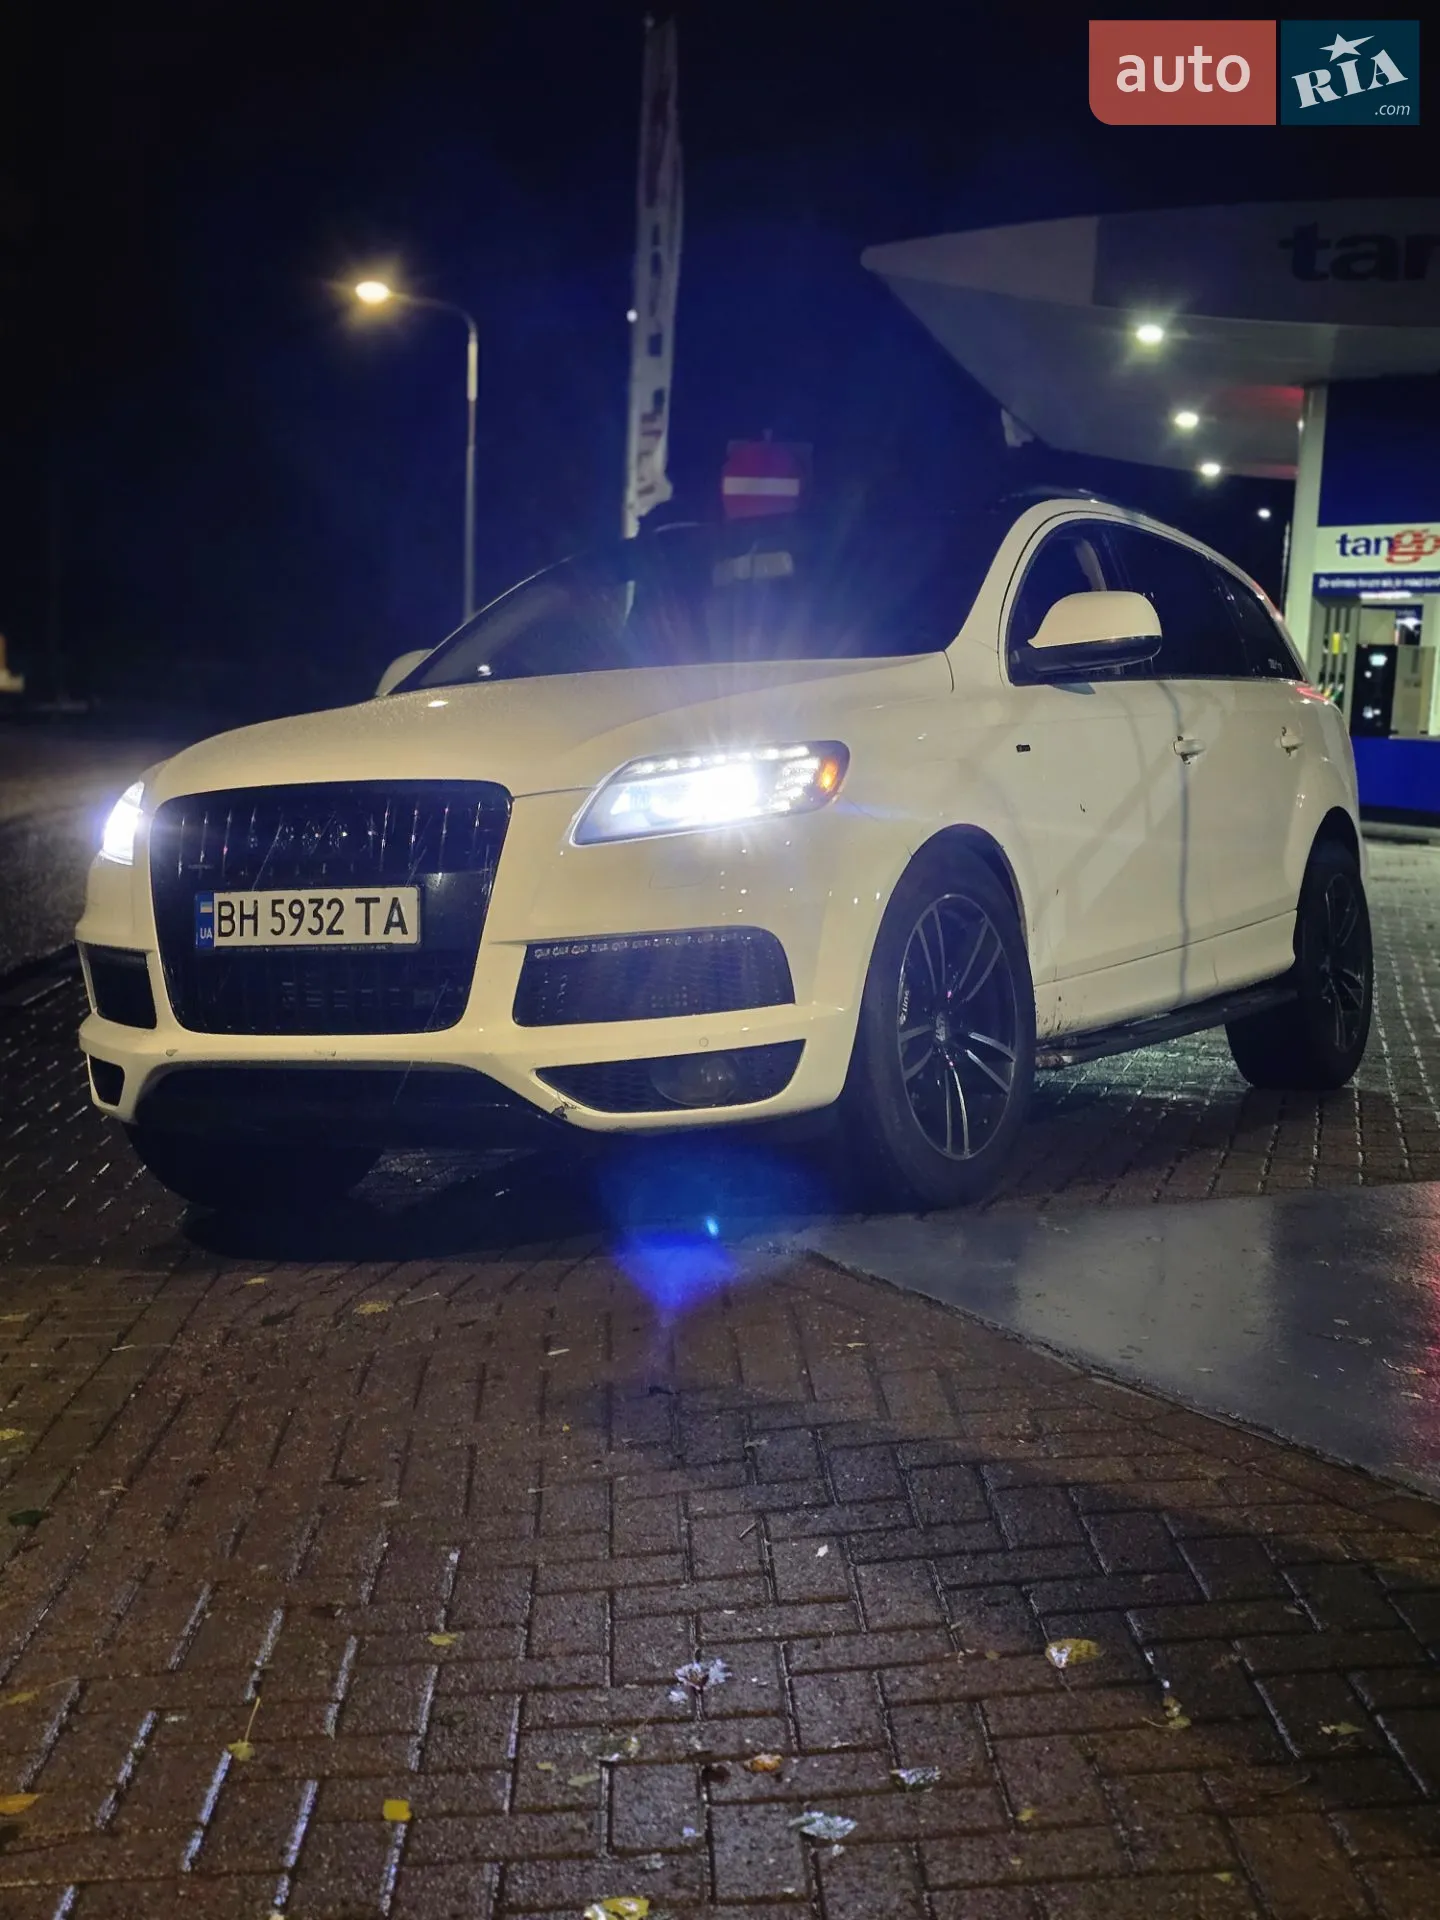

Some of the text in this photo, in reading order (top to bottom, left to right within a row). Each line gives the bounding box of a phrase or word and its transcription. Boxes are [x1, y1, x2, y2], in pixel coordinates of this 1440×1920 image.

[217, 896, 409, 938] BH 5932 TA
[199, 927, 213, 940] UA
